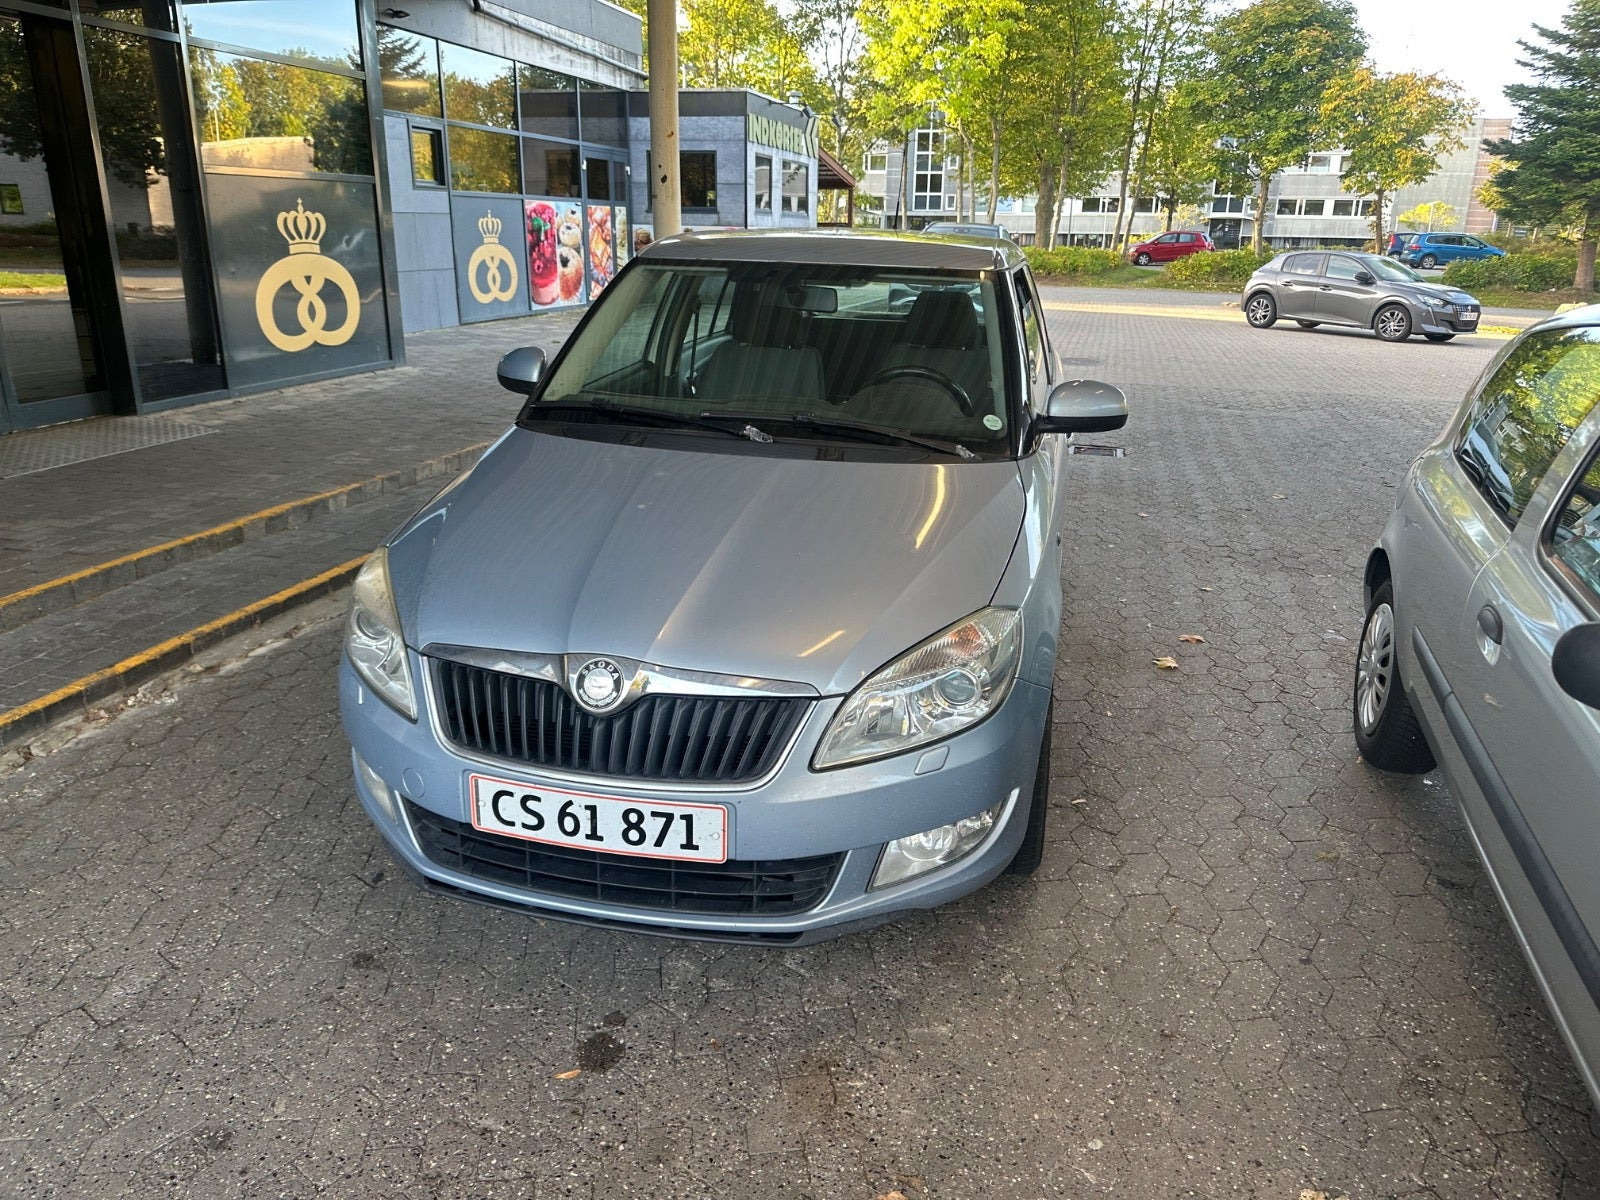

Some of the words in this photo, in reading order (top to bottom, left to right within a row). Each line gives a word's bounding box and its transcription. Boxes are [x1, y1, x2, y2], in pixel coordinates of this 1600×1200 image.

[748, 112, 803, 155] INDKØRSEL
[491, 790, 546, 832] CS
[557, 800, 604, 842] 61
[621, 808, 700, 851] 871
